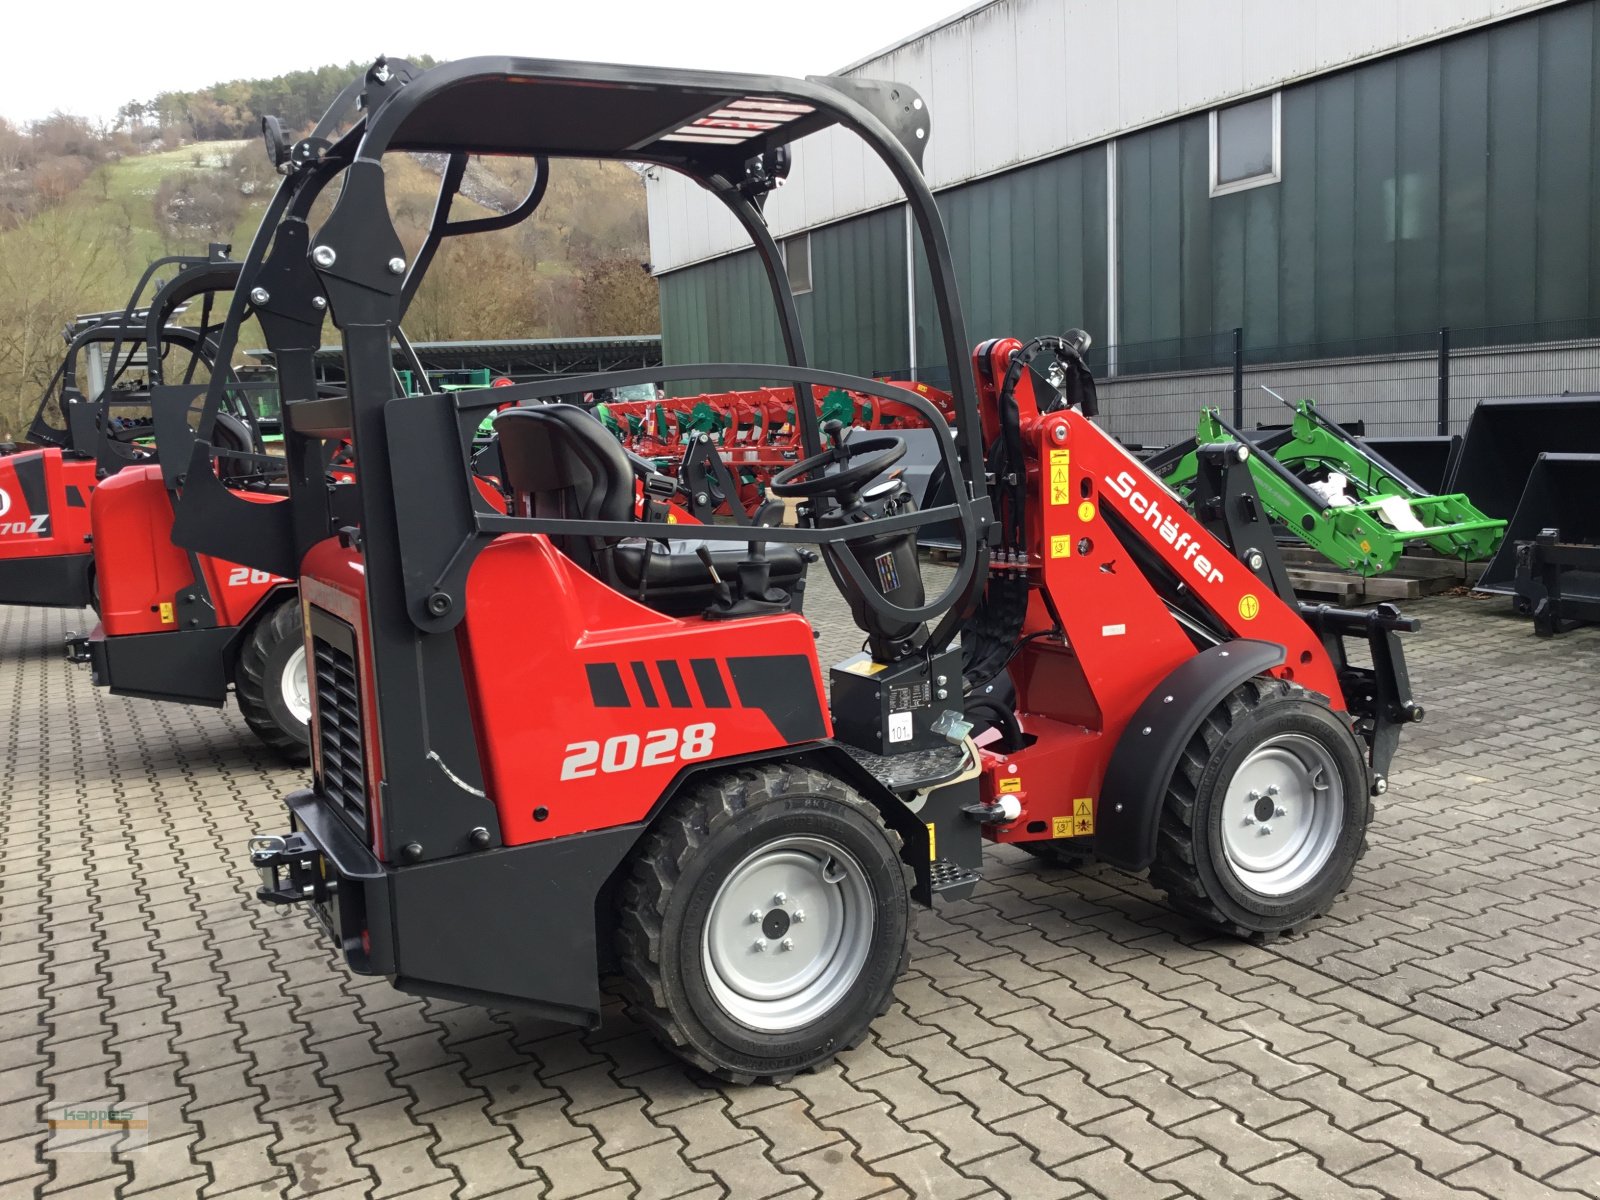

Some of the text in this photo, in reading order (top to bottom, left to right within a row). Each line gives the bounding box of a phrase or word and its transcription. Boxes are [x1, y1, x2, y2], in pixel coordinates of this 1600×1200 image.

[1105, 471, 1224, 584] Schäffer
[228, 567, 288, 587] 26
[560, 722, 716, 781] 2028
